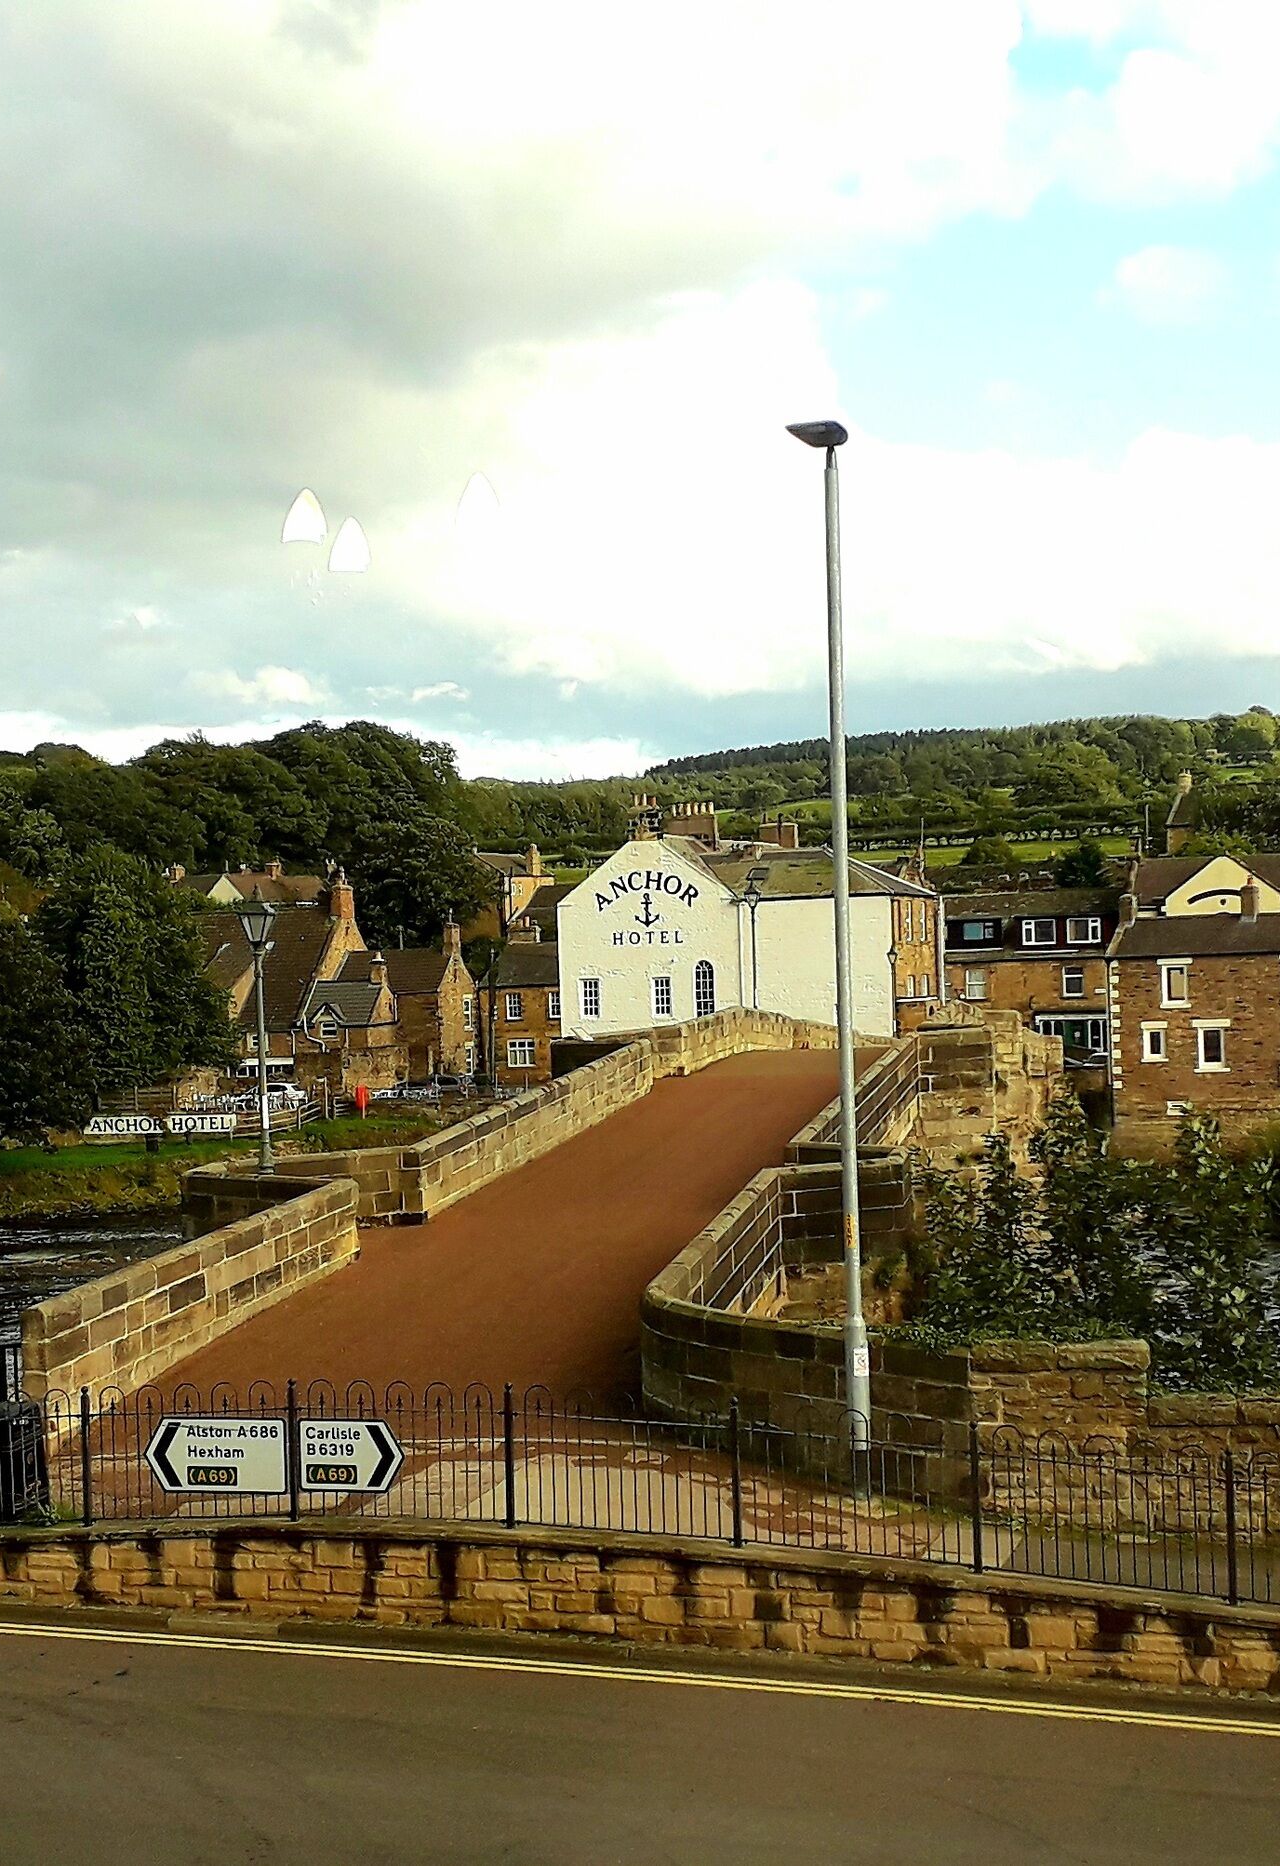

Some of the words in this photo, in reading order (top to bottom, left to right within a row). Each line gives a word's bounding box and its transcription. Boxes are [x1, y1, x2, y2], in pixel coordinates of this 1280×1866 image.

[595, 870, 699, 912] ANCHOR
[613, 931, 683, 945] HOTEL
[90, 1118, 162, 1132] ANCHOR
[172, 1116, 229, 1132] HOTEL
[186, 1425, 232, 1438] Alston
[305, 1426, 361, 1440] Carlisle
[187, 1445, 244, 1459] Hexham
